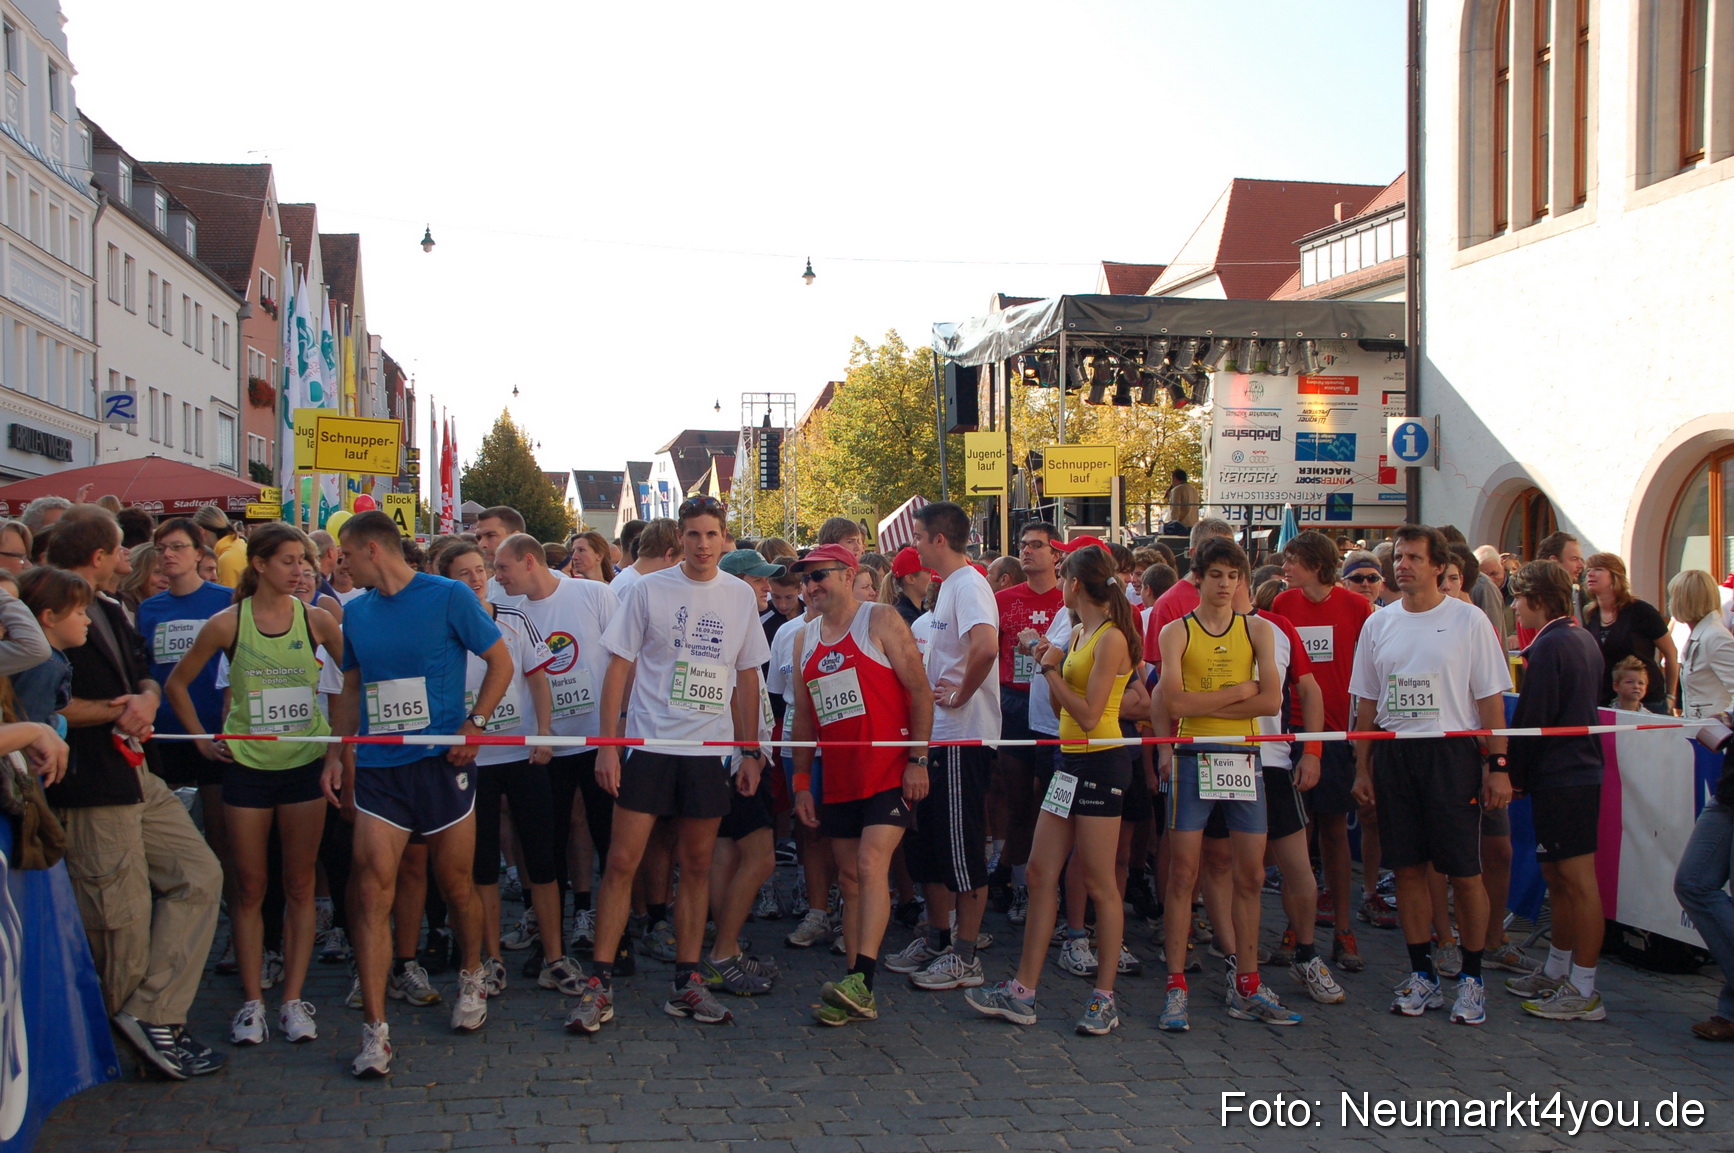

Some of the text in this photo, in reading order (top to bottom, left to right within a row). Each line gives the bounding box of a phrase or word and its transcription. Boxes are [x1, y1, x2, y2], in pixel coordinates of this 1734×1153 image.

[320, 431, 394, 448] Schnupper-
[345, 448, 368, 460] lauf
[967, 449, 1005, 460] Jugend-
[978, 461, 996, 470] lauf
[1048, 460, 1111, 472] Schnupper-
[1070, 473, 1090, 483] lauf
[1220, 472, 1279, 484] FISCHER
[387, 495, 412, 504] Block
[1220, 491, 1322, 500] AKTIENGESELLSCHAFT
[173, 499, 218, 508] Stadtcafé
[852, 506, 875, 515] Block
[393, 508, 408, 531] A
[696, 627, 723, 635] 16.09.2007
[169, 637, 194, 650] 508
[674, 639, 684, 647] 8.
[1302, 639, 1329, 651] 192
[690, 650, 720, 659] Stadtlauf
[690, 667, 716, 678] Markus
[551, 677, 576, 688] Markus
[1398, 678, 1430, 688] Wolfgang
[557, 688, 590, 706] 5012
[689, 684, 723, 700] 5085
[825, 690, 857, 710] 5186
[1400, 693, 1433, 706] 5131
[268, 703, 308, 719] 5166
[384, 700, 423, 718] 5165
[1213, 758, 1234, 766] Kevin
[1216, 774, 1251, 787] 5080
[1053, 787, 1072, 804] 5000
